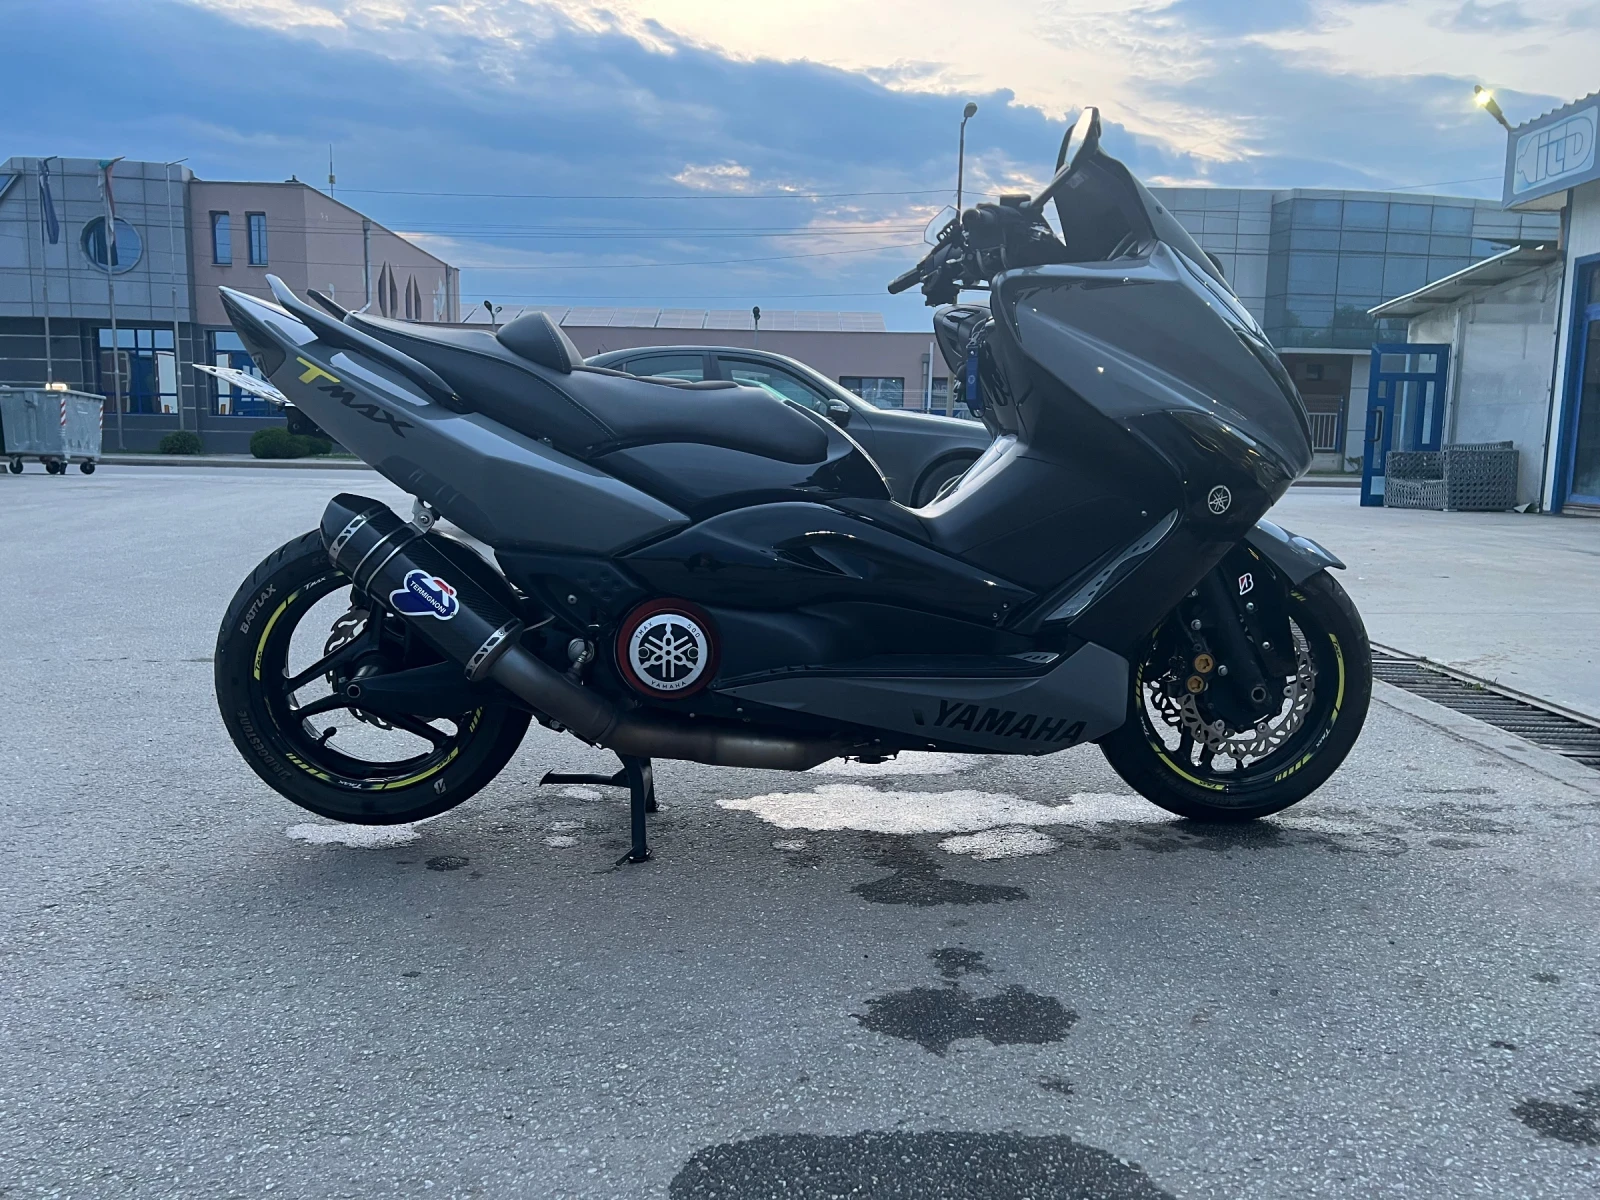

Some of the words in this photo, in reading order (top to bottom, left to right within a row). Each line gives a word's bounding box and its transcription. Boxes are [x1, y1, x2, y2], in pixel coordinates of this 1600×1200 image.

[408, 580, 448, 614] TERMIGNONI
[635, 621, 653, 639] TMAX
[686, 623, 701, 639] 500
[651, 680, 687, 690] YAMAHA
[933, 699, 1088, 744] YAMAHA
